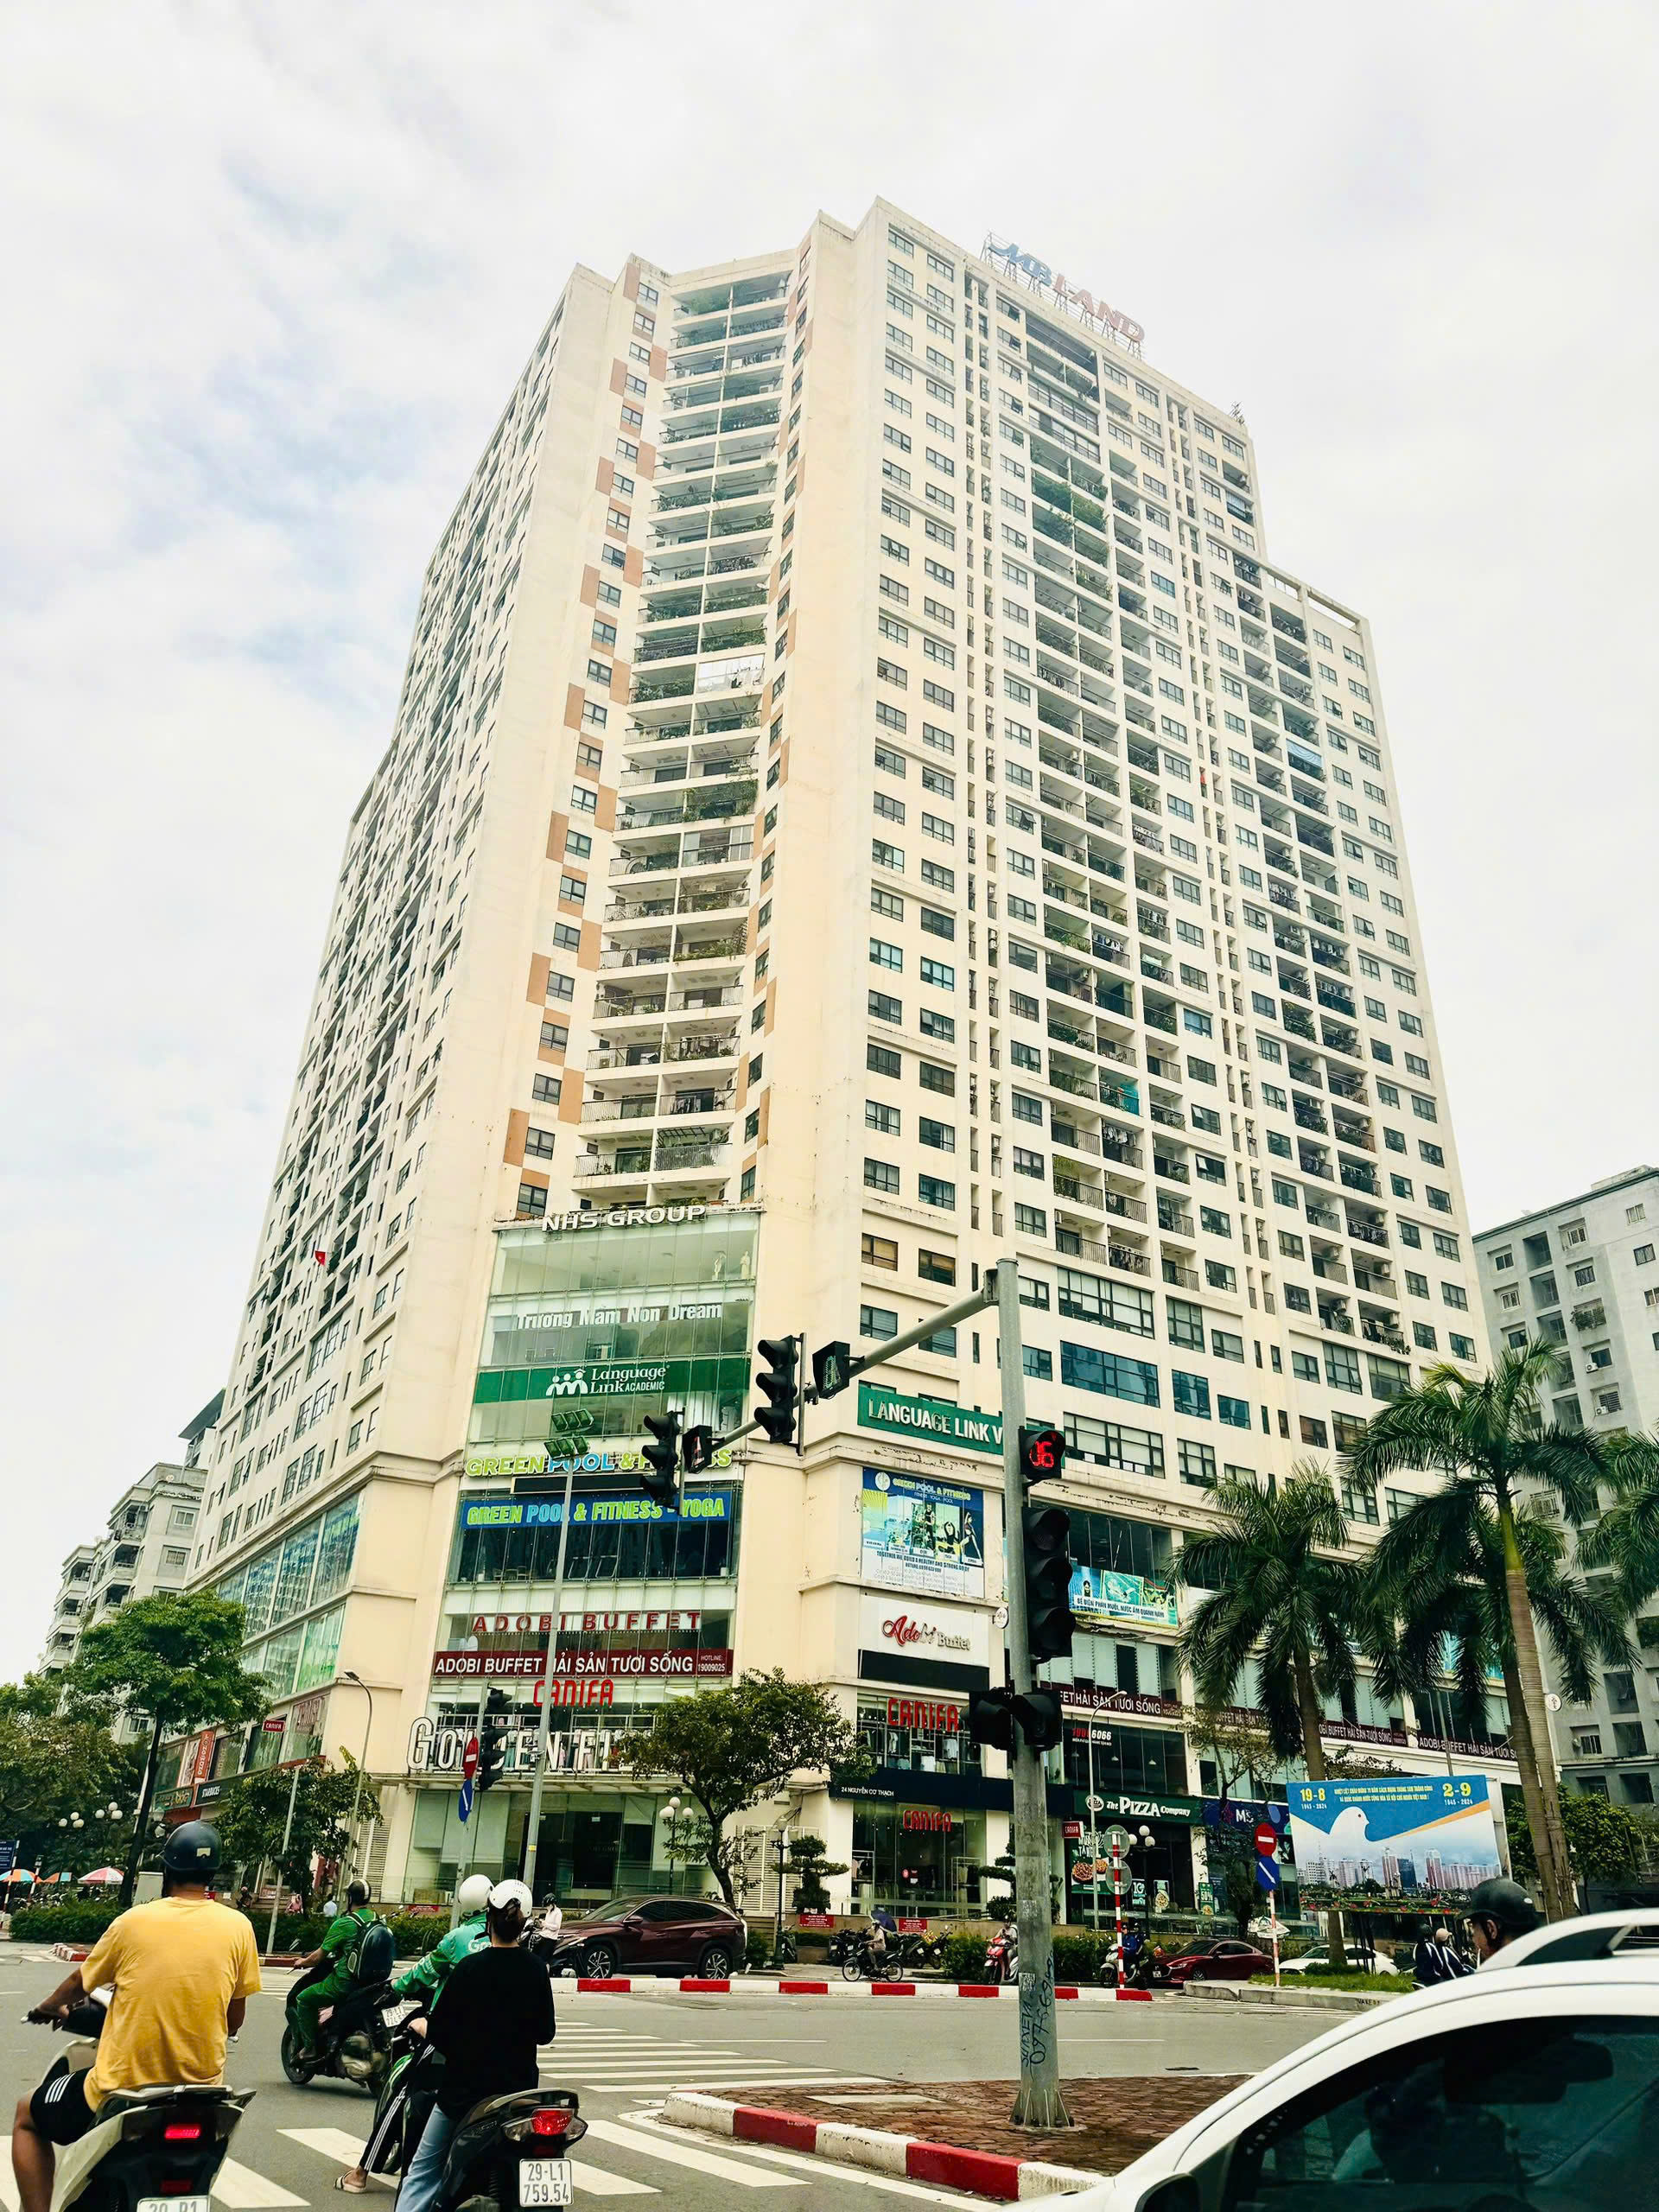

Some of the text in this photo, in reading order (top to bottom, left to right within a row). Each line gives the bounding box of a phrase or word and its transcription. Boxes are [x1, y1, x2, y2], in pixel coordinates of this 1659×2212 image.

[542, 1205, 706, 1232] NHS GROUP
[627, 1306, 661, 1322] Non
[668, 1303, 721, 1321] Dream
[591, 1367, 666, 1382] Language
[589, 1380, 665, 1394] Link ACADEMIC
[868, 1398, 951, 1434] LANGUAGE
[955, 1417, 990, 1443] LINK
[465, 1455, 545, 1477] GREEN
[619, 1452, 636, 1471] &
[467, 1505, 523, 1525] GREEN
[574, 1503, 587, 1521] &
[592, 1500, 663, 1521] FITNESS
[682, 1498, 725, 1518] YOGA
[472, 1611, 702, 1632] ADOBI BUFFET
[435, 1657, 481, 1673] ADOBI
[485, 1657, 543, 1674] BUFFET
[575, 1651, 606, 1673] SẢN
[611, 1655, 645, 1673] TƯƠI
[649, 1649, 694, 1673] SỐNG
[697, 1663, 726, 1672] 19009025
[533, 1679, 614, 1707] CANIFA
[1076, 1690, 1090, 1706] HẢI
[1135, 1697, 1161, 1714] SỐNG
[887, 1698, 959, 1732] CANIFA
[1091, 1729, 1112, 1741] 6066
[1328, 1726, 1346, 1738] BUFFET
[1442, 1782, 1472, 1797] 2-9
[1106, 1801, 1119, 1810] The
[1119, 1796, 1161, 1818] PIZZA
[1160, 1805, 1192, 1817] Company
[903, 1809, 952, 1833] CANIFA
[528, 2163, 563, 2182] 29-L1
[524, 2183, 569, 2203] 759.54
